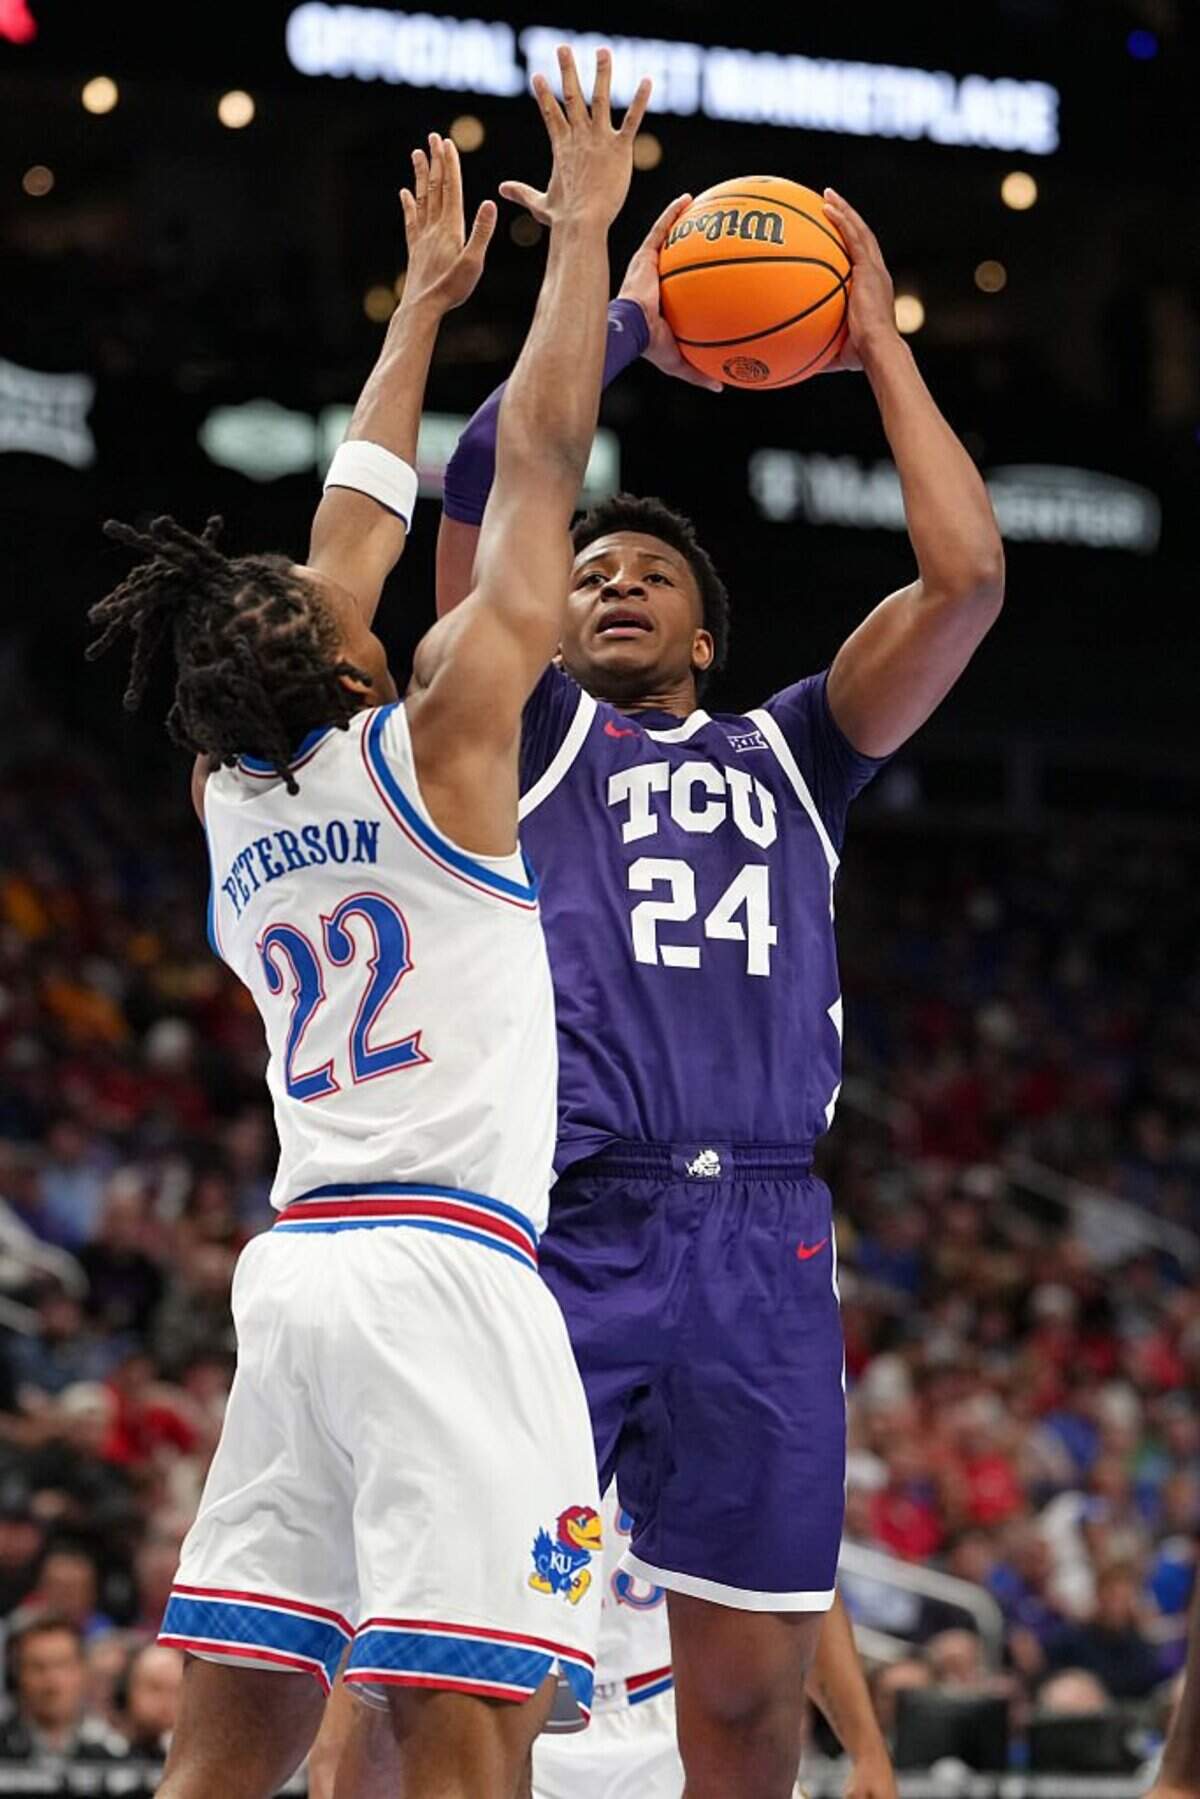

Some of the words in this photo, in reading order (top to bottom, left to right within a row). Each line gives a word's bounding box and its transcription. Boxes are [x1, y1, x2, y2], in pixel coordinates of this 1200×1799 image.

[608, 761, 778, 849] TCU
[221, 819, 380, 921] PETERSON
[628, 857, 778, 977] 24
[256, 891, 432, 1103] 22
[550, 1550, 573, 1575] KU
